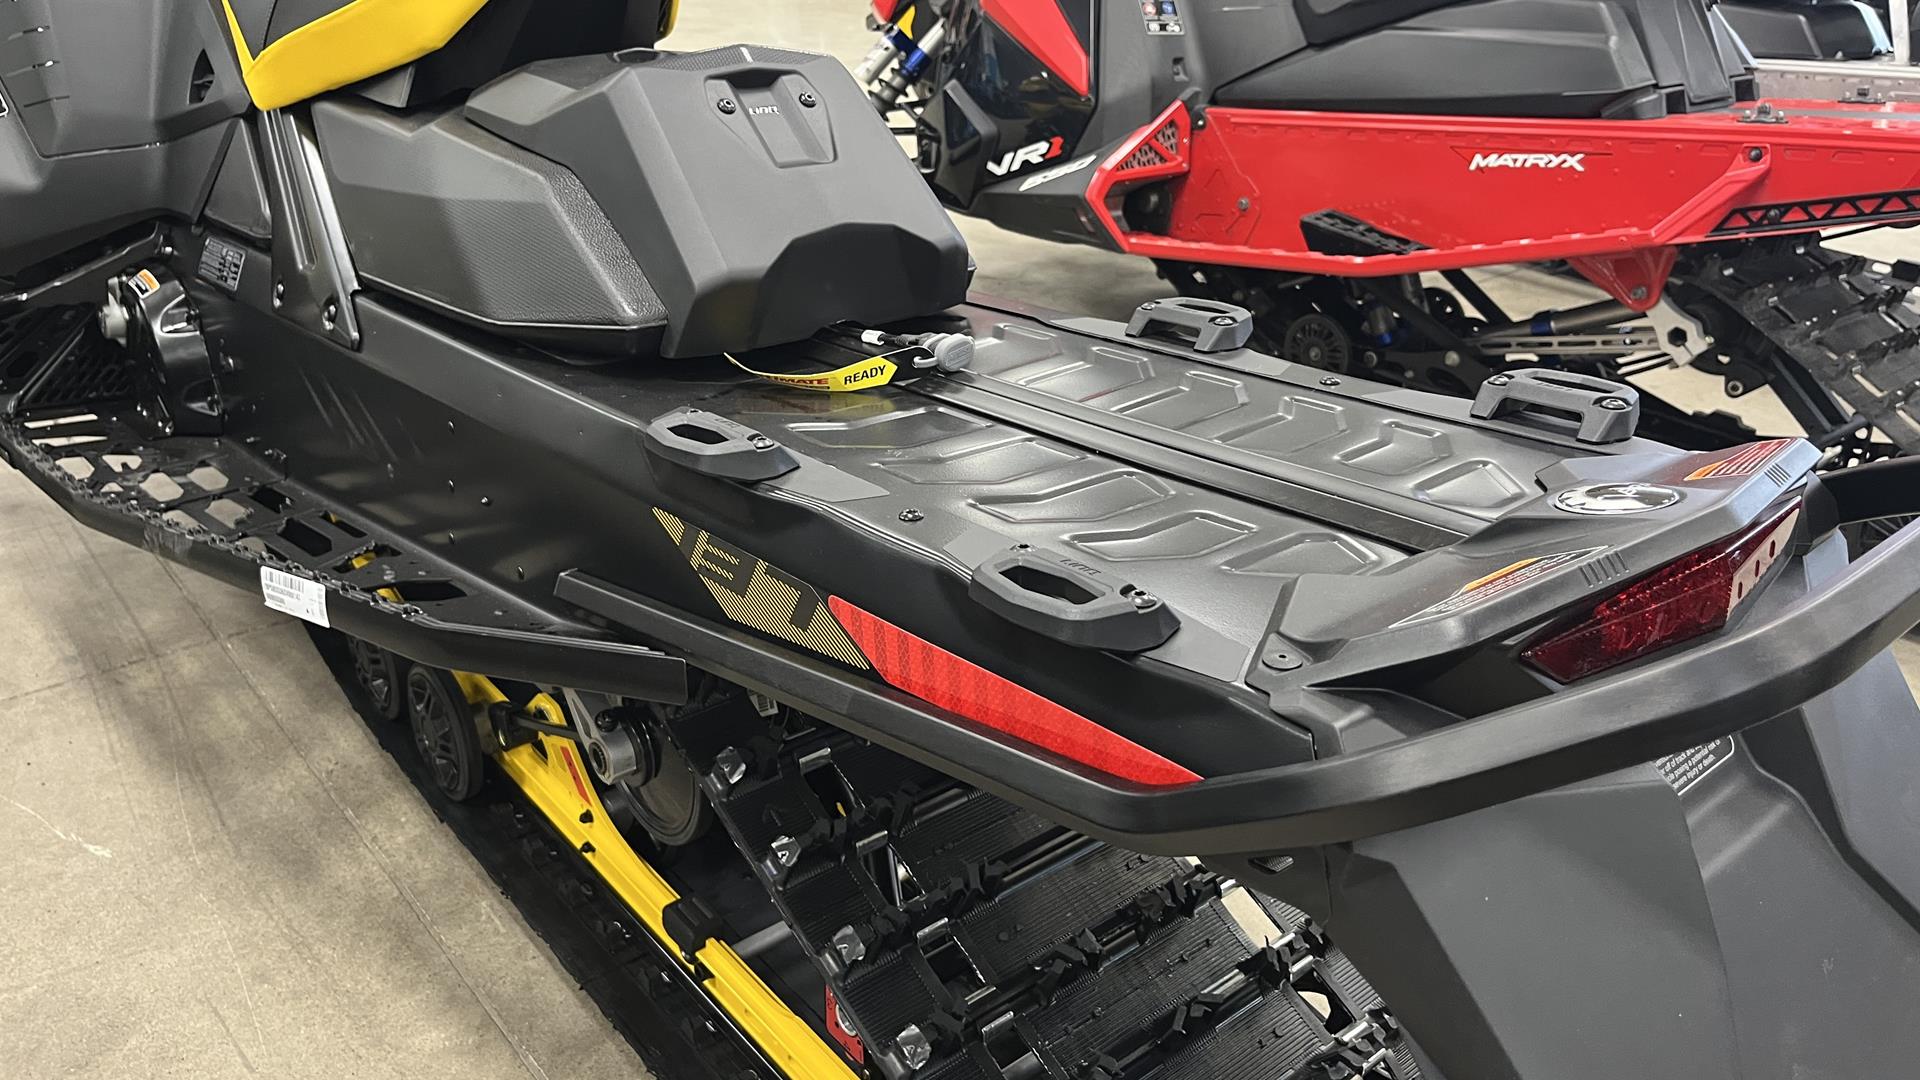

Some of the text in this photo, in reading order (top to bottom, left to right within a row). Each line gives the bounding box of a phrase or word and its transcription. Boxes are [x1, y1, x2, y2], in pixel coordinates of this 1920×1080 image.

[986, 136, 1064, 176] VR1
[1468, 153, 1586, 171] MATRYX
[844, 365, 886, 385] READY
